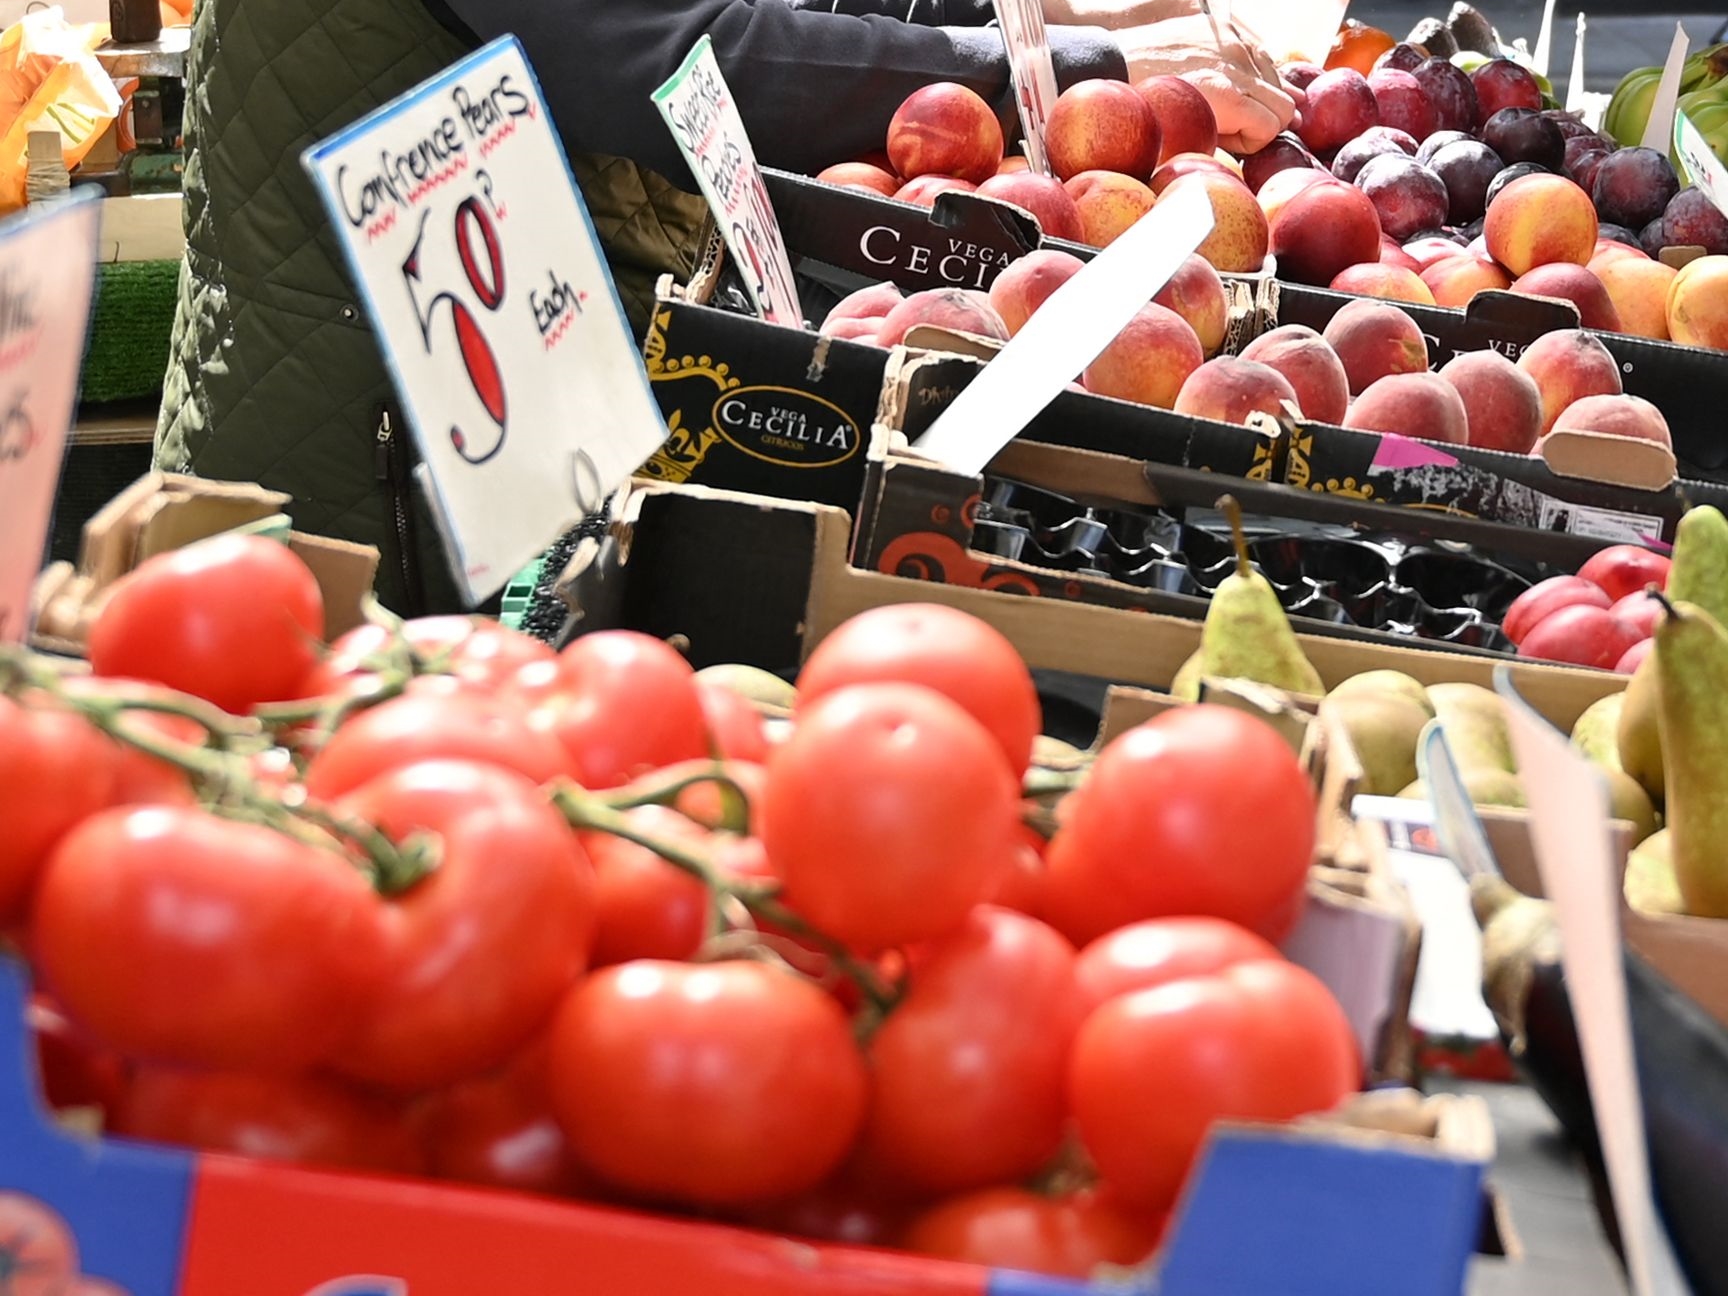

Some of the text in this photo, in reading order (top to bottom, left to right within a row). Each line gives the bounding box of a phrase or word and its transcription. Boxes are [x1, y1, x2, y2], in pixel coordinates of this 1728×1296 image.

[859, 225, 1003, 289] CECI
[948, 238, 1011, 267] VEGA
[721, 400, 848, 450] CECILIA
[770, 406, 807, 424] VEGA
